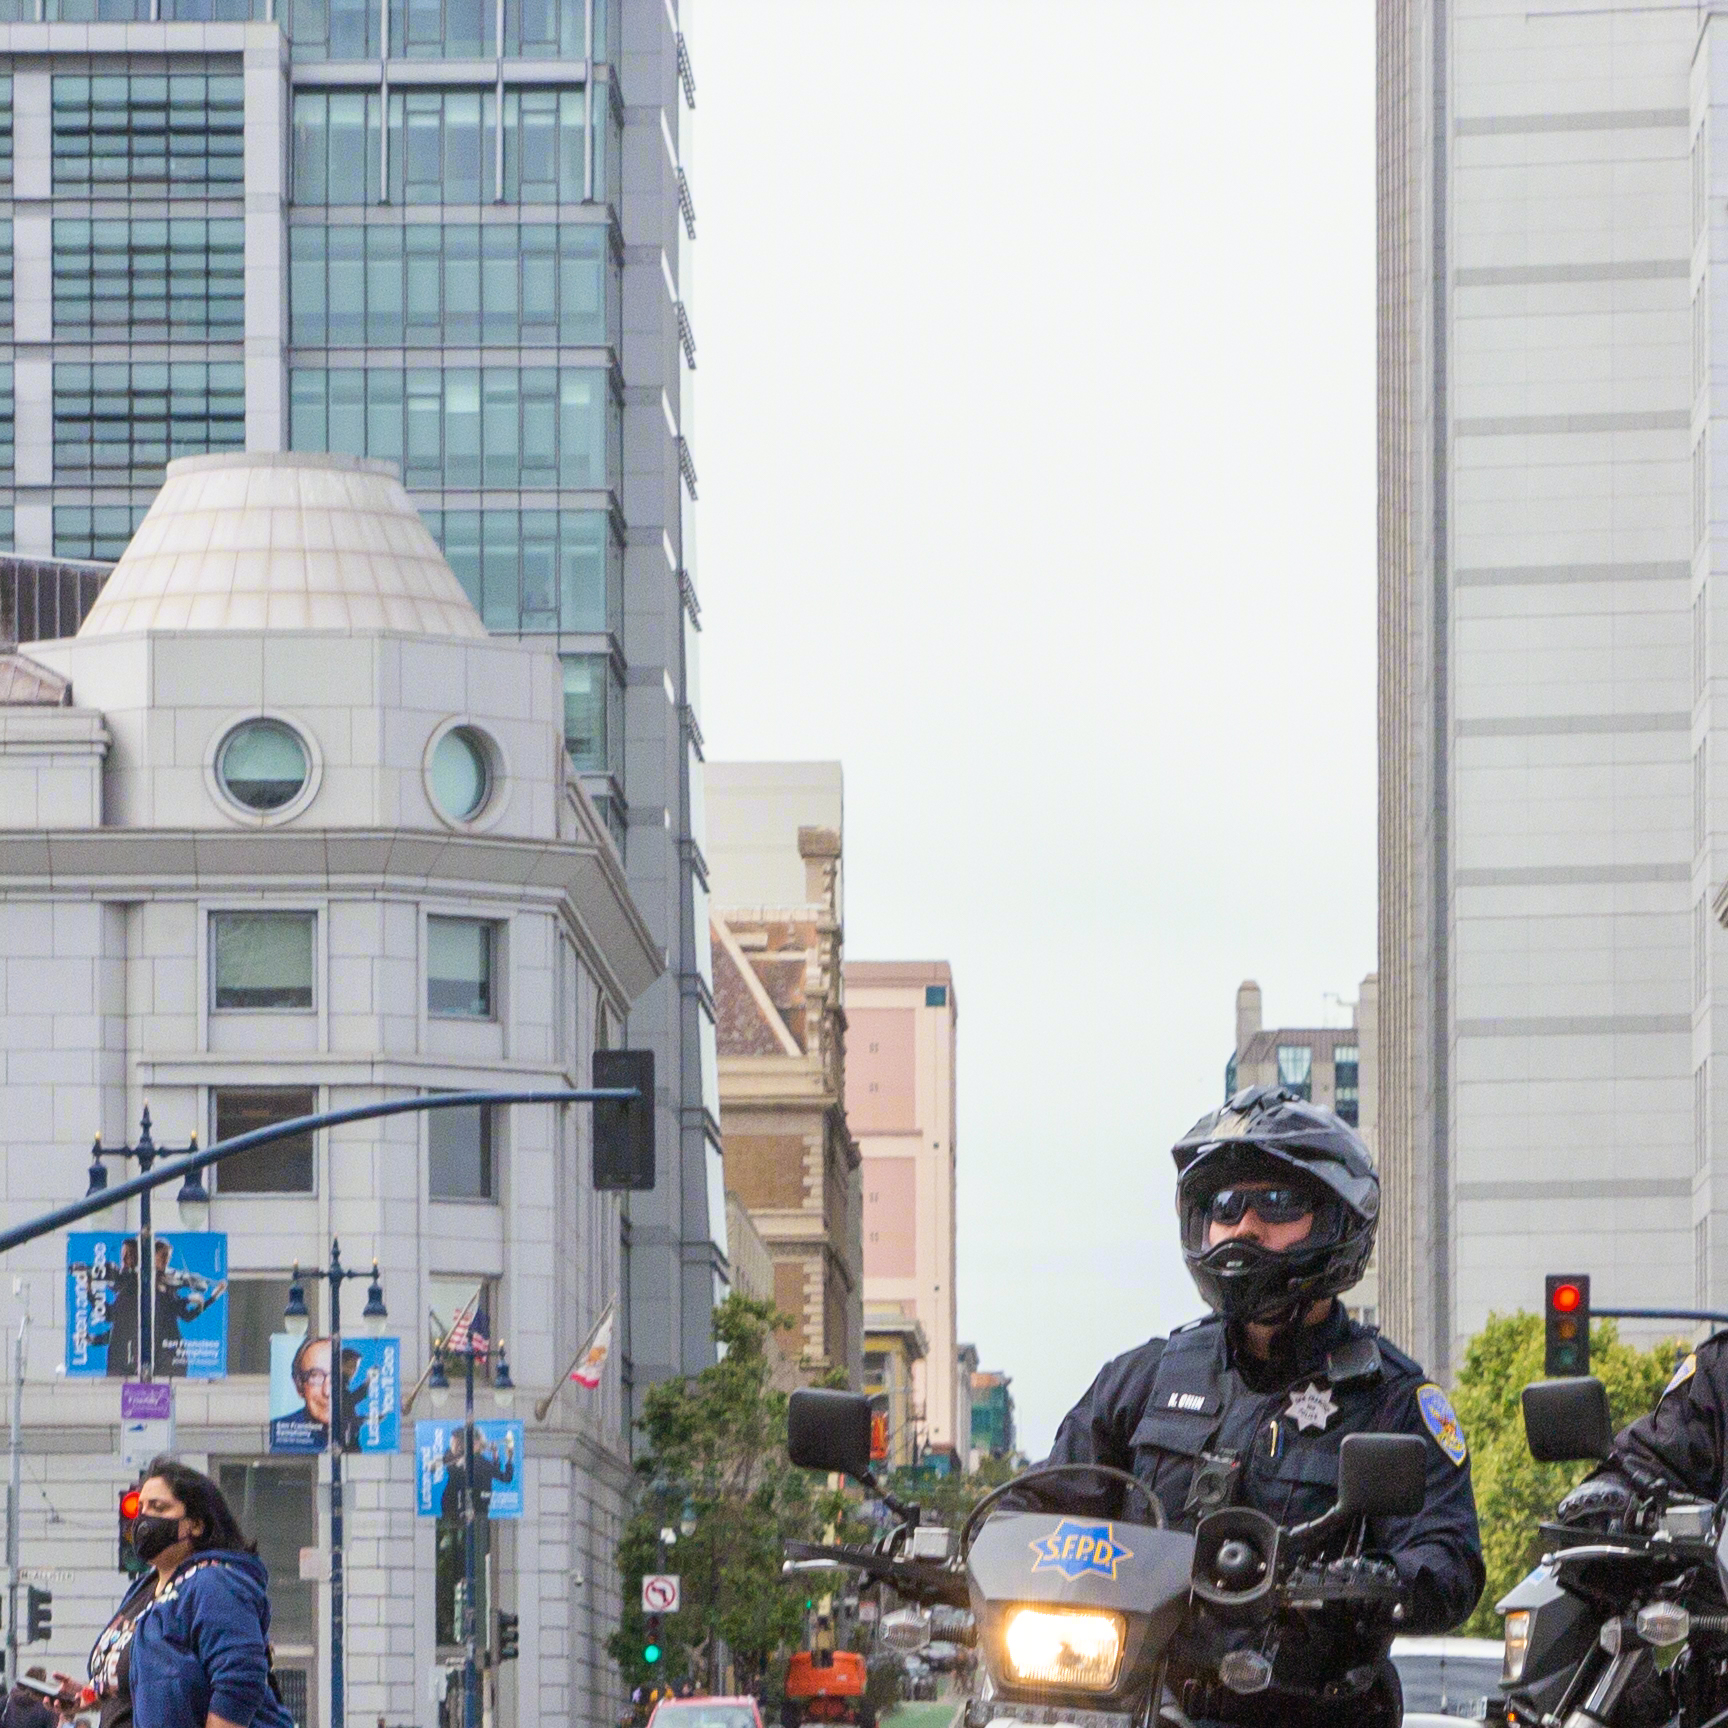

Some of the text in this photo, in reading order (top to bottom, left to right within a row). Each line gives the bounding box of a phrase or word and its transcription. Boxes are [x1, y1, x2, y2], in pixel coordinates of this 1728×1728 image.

[91, 1241, 107, 1280] See
[71, 1309, 88, 1366] Listen
[1042, 1534, 1113, 1567] S.F.P.D.
